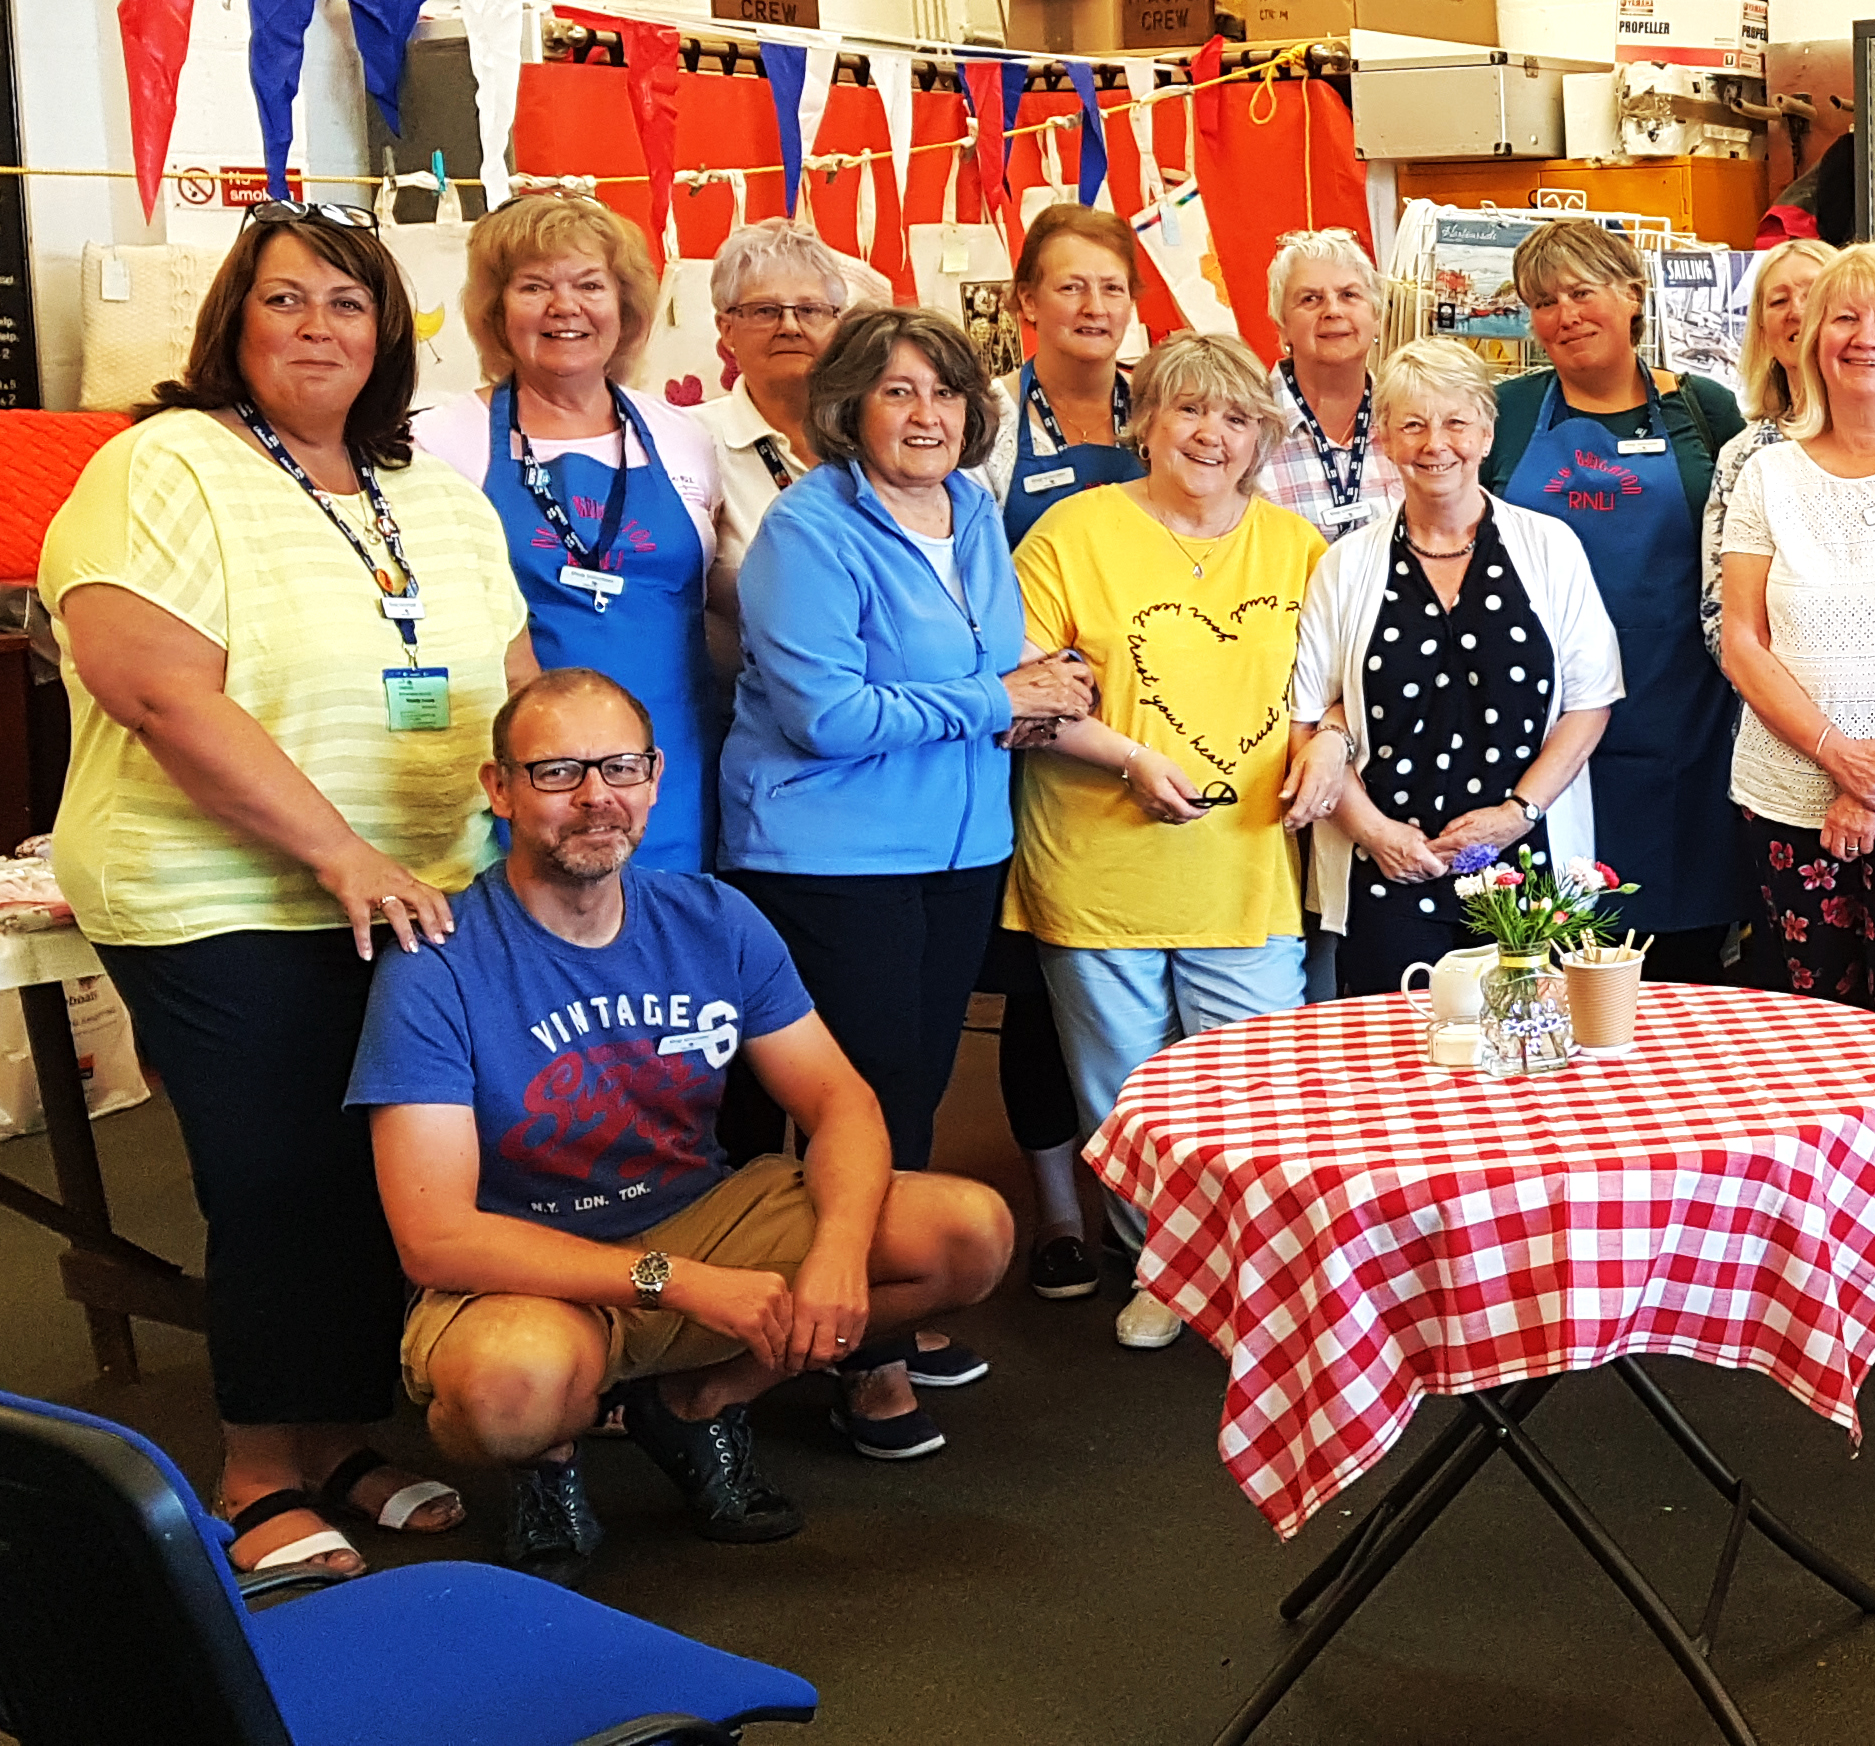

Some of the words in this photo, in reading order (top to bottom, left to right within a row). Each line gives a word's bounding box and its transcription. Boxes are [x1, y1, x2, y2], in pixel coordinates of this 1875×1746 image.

[741, 0, 797, 22] CREW
[1141, 8, 1188, 30] CREW
[1619, 20, 1670, 34] PROPELLER
[1666, 259, 1713, 280] SAILING
[1569, 490, 1615, 511] RNLI
[1127, 634, 1160, 687] trust
[1139, 695, 1187, 735] your
[1238, 706, 1280, 755] trust
[1189, 735, 1237, 775] heart
[530, 993, 691, 1054] VINTAGE
[697, 1000, 738, 1070] 6
[531, 1202, 559, 1214] N.Y.
[574, 1194, 609, 1212] LDN.
[618, 1181, 651, 1202] TOK.
